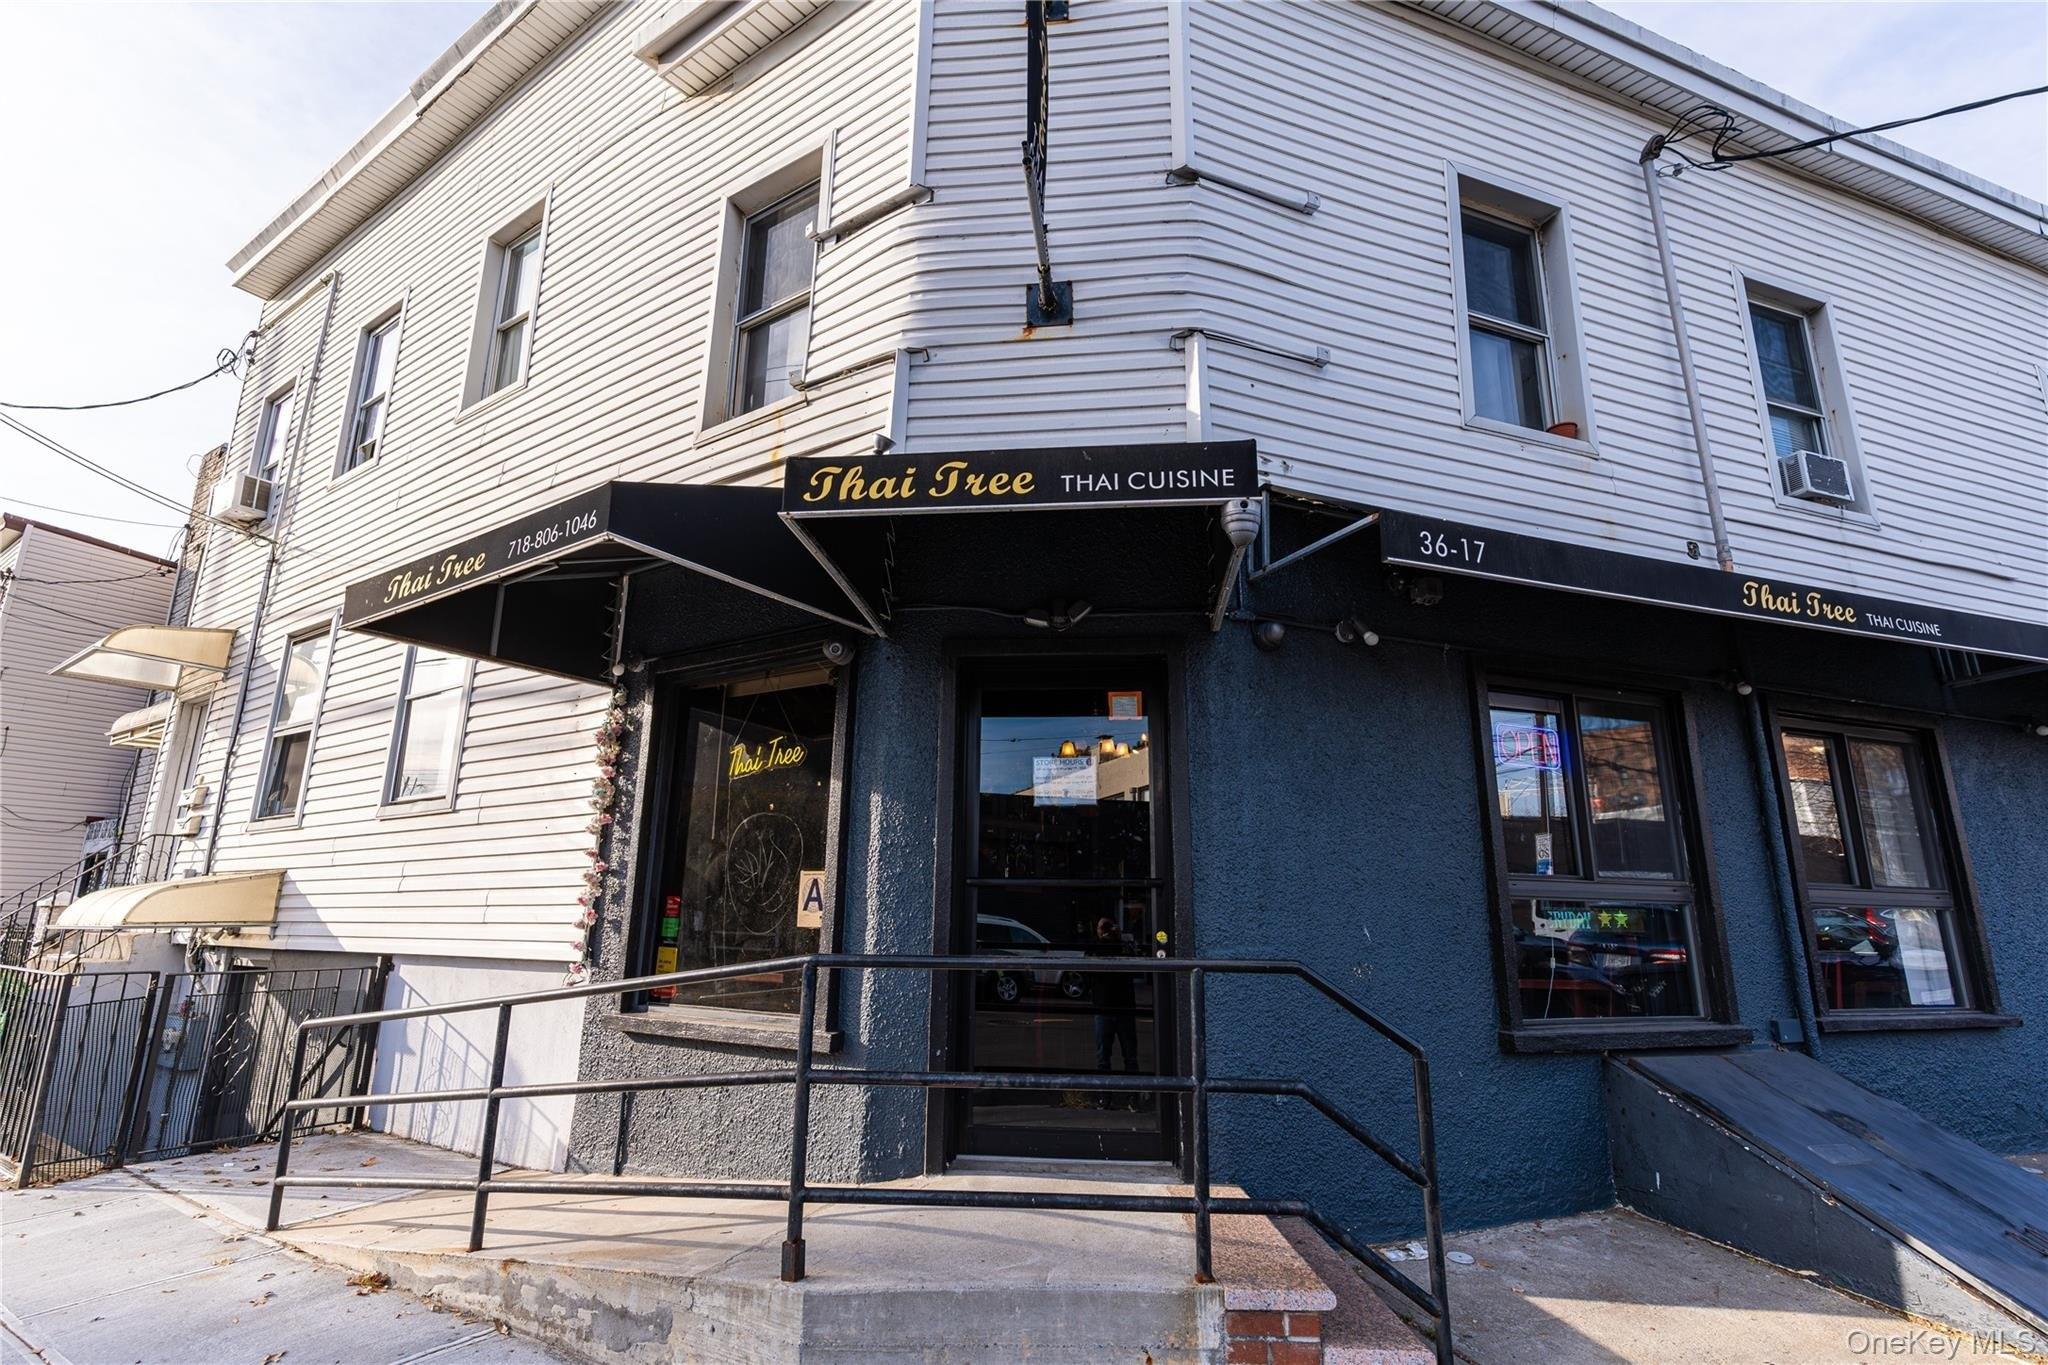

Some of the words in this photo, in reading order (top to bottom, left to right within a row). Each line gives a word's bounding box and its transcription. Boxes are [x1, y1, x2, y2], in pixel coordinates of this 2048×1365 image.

[804, 465, 916, 504] Thai
[928, 461, 1036, 498] Tree
[1061, 473, 1119, 493] THAI
[1128, 468, 1236, 491] CUISINE
[507, 510, 597, 559] 718-806-1046
[1419, 531, 1486, 564] 36-17
[384, 566, 434, 604] Thai
[436, 552, 486, 585] Tree
[1742, 581, 1802, 615] Thai
[1803, 591, 1858, 624] Tree
[1866, 613, 1895, 634] THAI
[1896, 617, 1943, 637] CUISINE
[728, 744, 763, 778] Thai
[768, 735, 805, 769] Tree
[1501, 730, 1556, 765] OPEN
[802, 878, 824, 912] A
